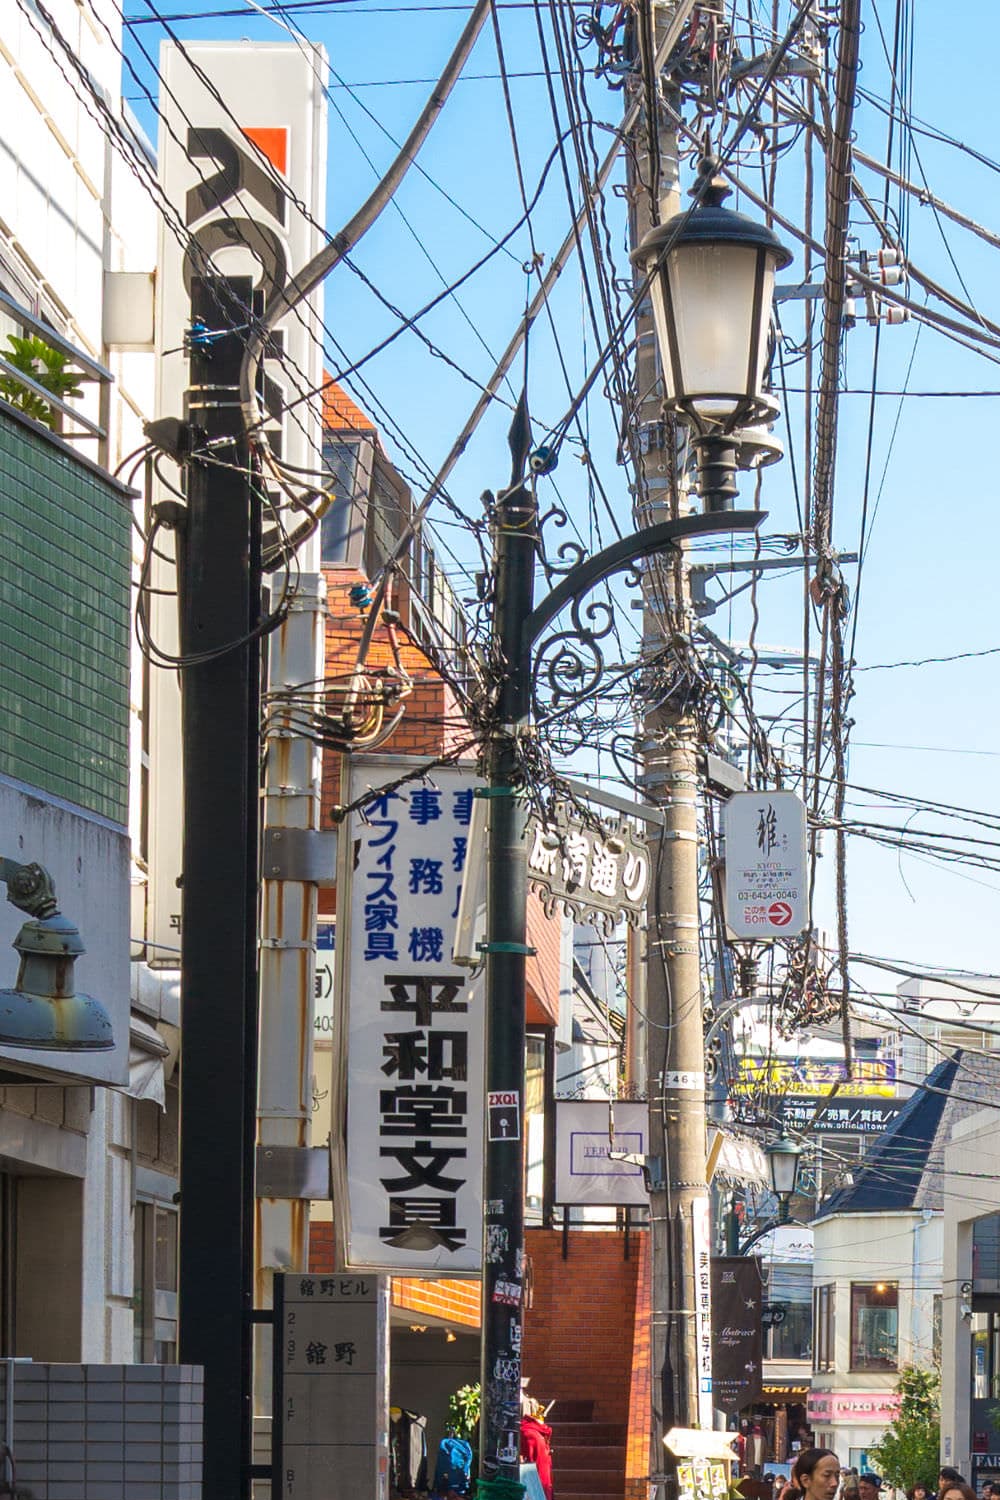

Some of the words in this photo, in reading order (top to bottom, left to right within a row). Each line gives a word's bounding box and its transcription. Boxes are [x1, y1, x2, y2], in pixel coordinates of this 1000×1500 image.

[364, 791, 399, 961] オフィス家具
[408, 788, 444, 962] 事務機
[379, 975, 468, 1252] 平和堂文具
